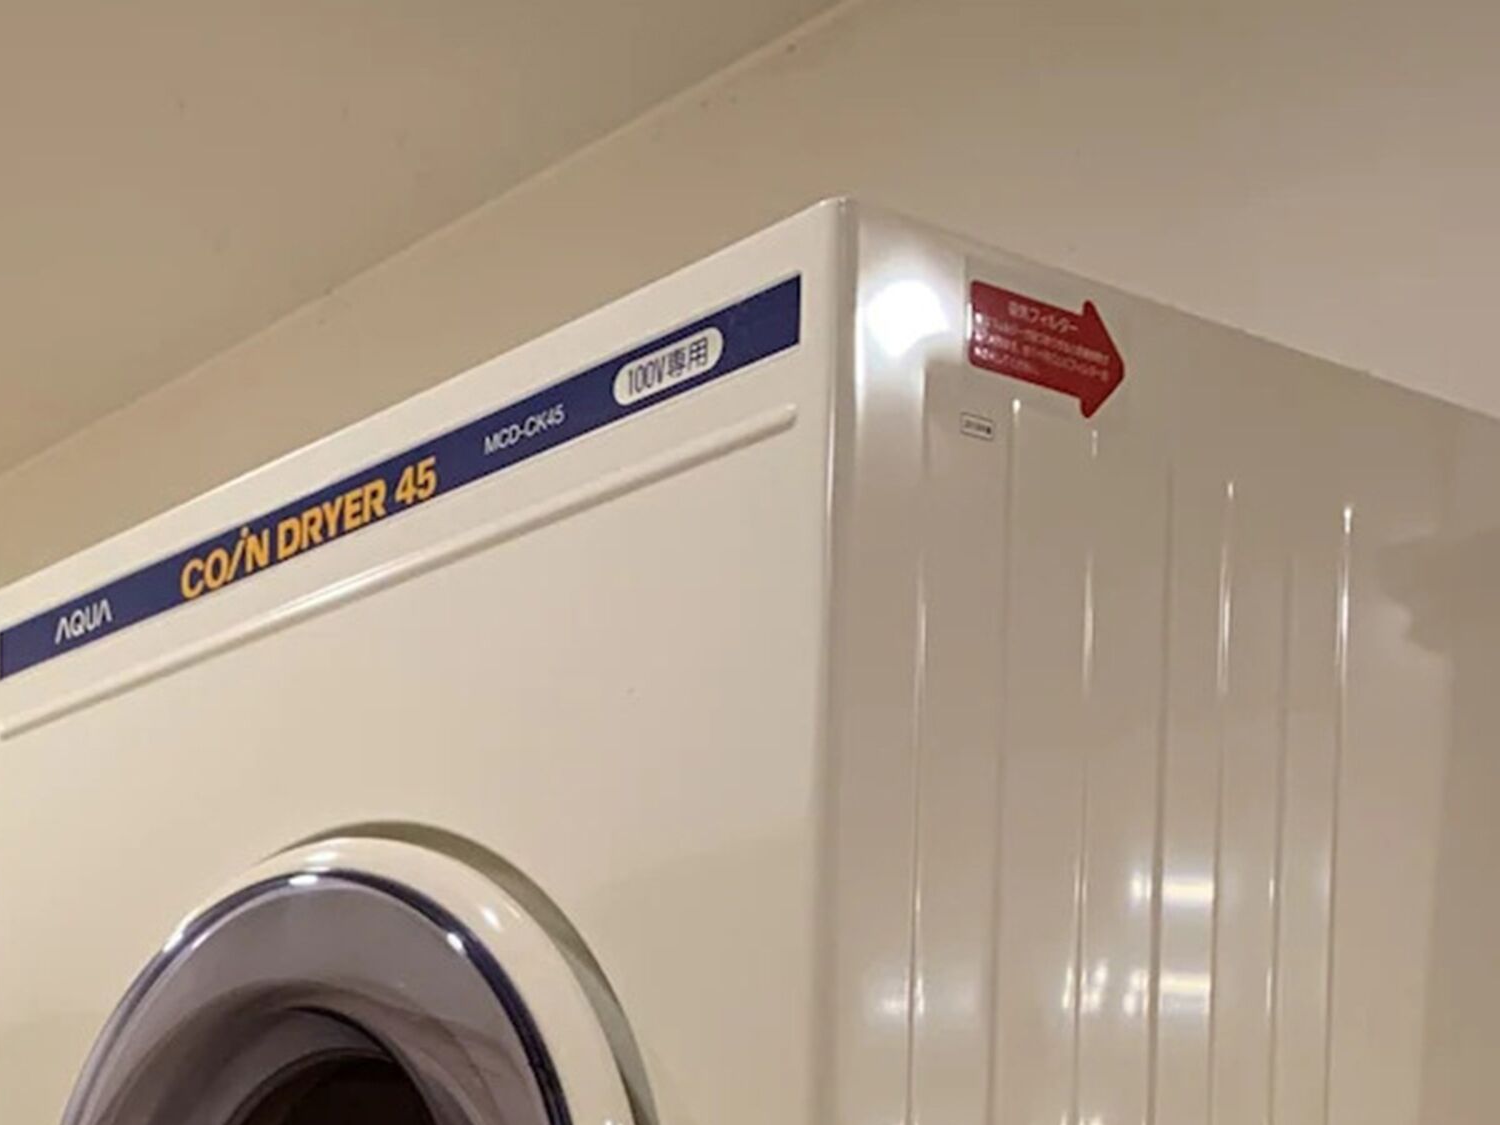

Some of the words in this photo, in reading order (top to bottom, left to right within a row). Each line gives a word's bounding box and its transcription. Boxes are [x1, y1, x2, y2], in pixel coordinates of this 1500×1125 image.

[627, 336, 709, 396] 100V専用
[483, 404, 565, 455] MCD-CK45
[277, 479, 387, 560] DRYER
[395, 456, 438, 505] 45
[54, 598, 113, 644] AQUA
